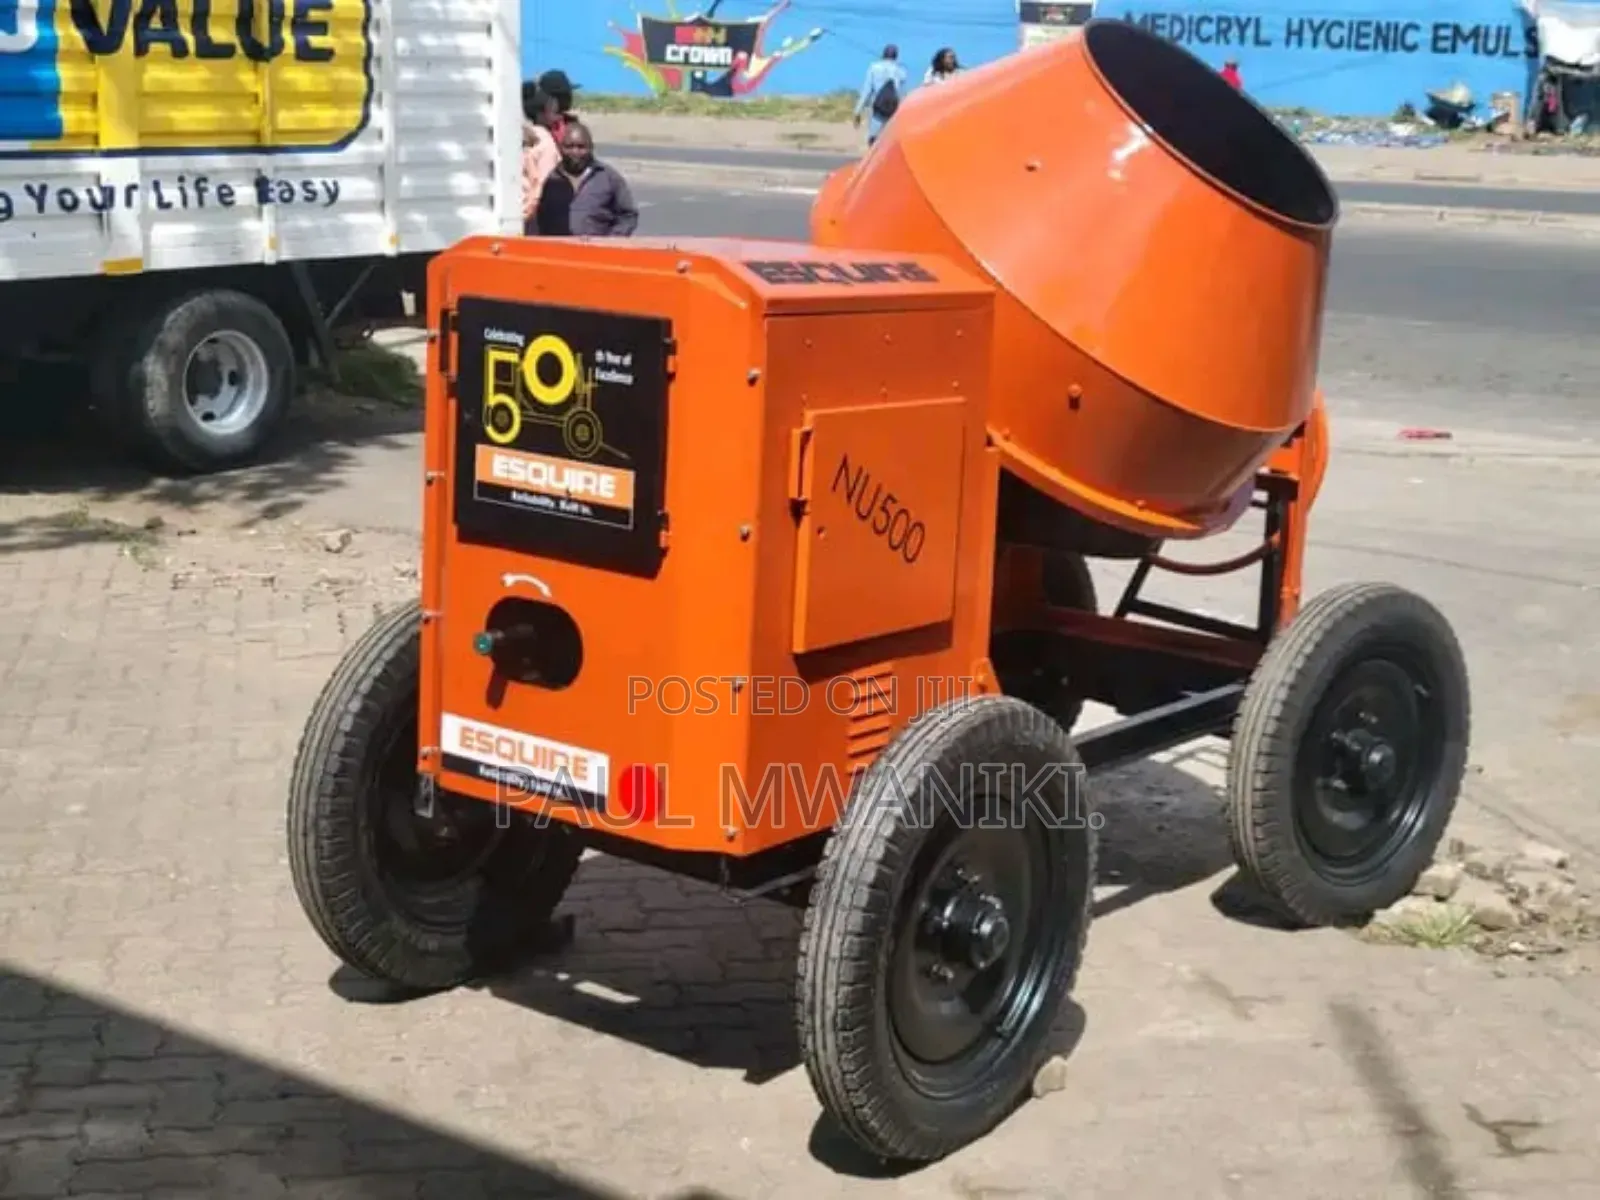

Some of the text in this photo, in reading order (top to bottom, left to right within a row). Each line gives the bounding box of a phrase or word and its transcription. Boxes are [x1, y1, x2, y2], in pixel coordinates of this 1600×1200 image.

[70, 0, 337, 62] VALUE
[1286, 18, 1421, 54] HYGIENIC
[665, 44, 732, 65] crown
[24, 182, 139, 214] Your
[153, 175, 235, 209] Life
[255, 174, 340, 208] Easy
[486, 334, 577, 444] 50
[491, 454, 617, 499] ESQUIRE
[832, 452, 925, 564] NU500
